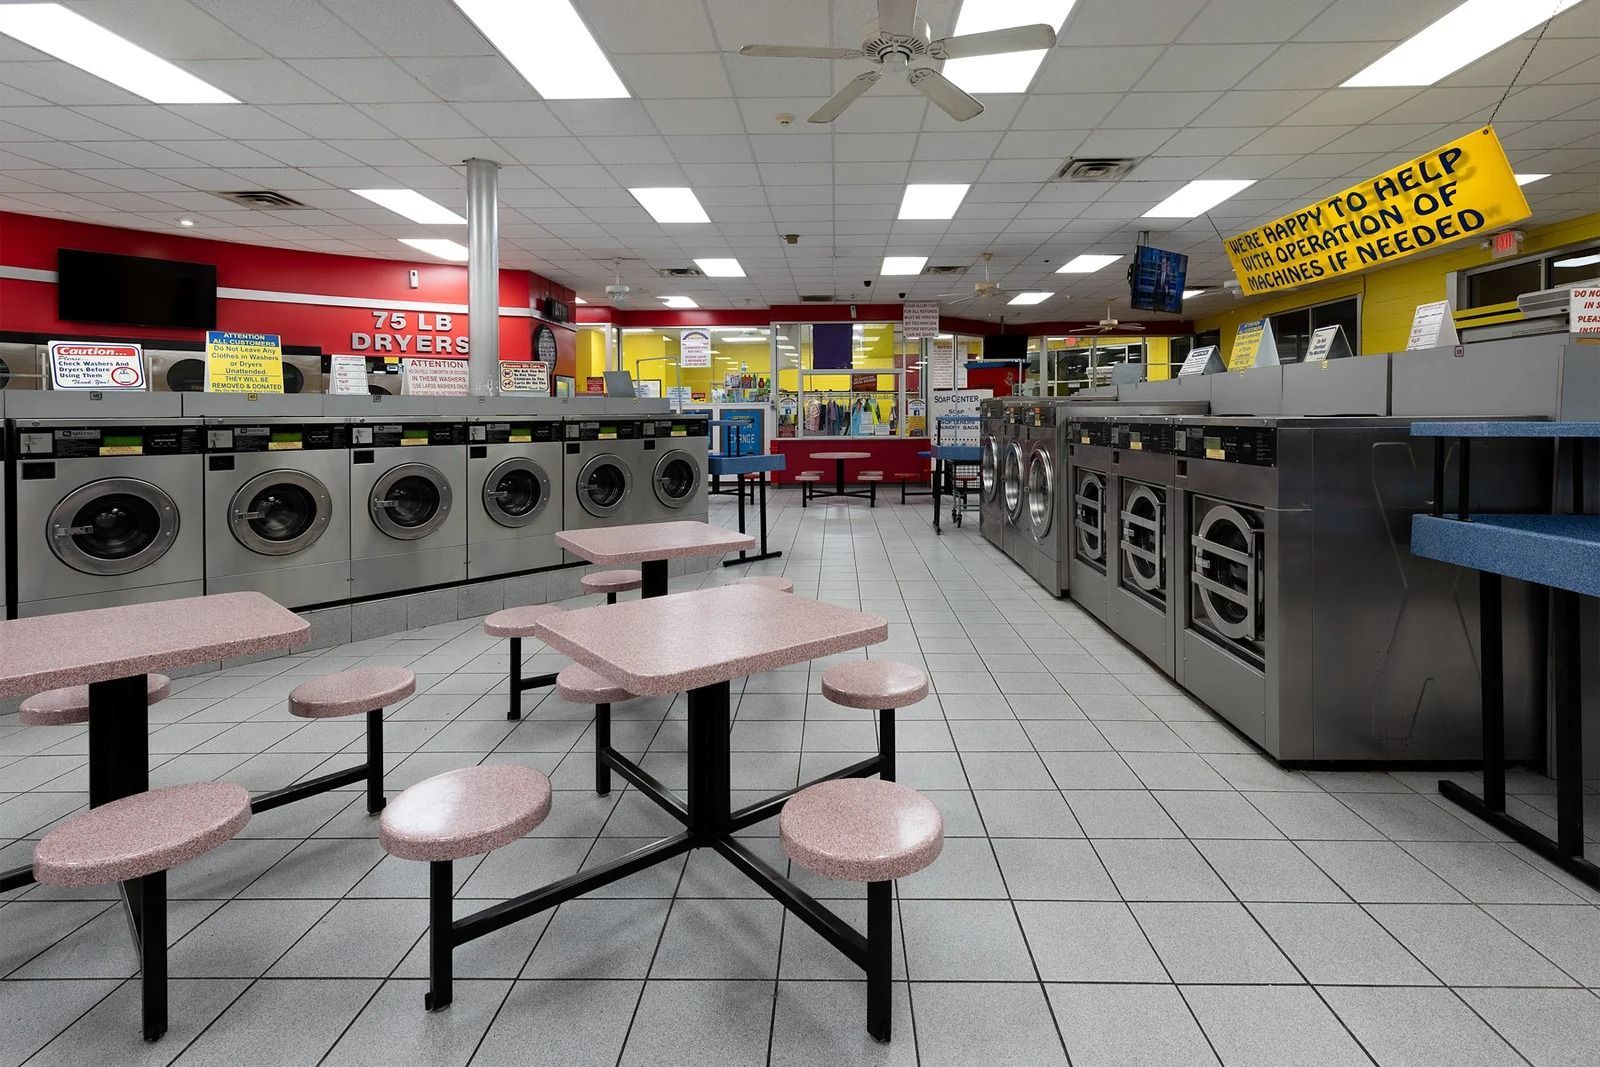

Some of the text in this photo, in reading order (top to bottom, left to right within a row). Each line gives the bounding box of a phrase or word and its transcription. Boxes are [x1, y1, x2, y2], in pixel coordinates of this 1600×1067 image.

[1229, 147, 1462, 255] WE'RE HAPPY TO HELP
[1241, 180, 1457, 273] WITH OPERATION OF
[1247, 208, 1485, 291] MACHINES IF NEEDED
[1496, 231, 1515, 254] EXIT
[1574, 290, 1587, 298] DO
[1584, 301, 1595, 309] IN
[372, 311, 453, 332] 75 LB
[229, 339, 276, 347] CUSTOMERS
[351, 332, 469, 354] DRYERS
[59, 347, 127, 355] Caution...
[410, 360, 464, 368] ATTENTION
[934, 395, 979, 403] SOAP CENTER
